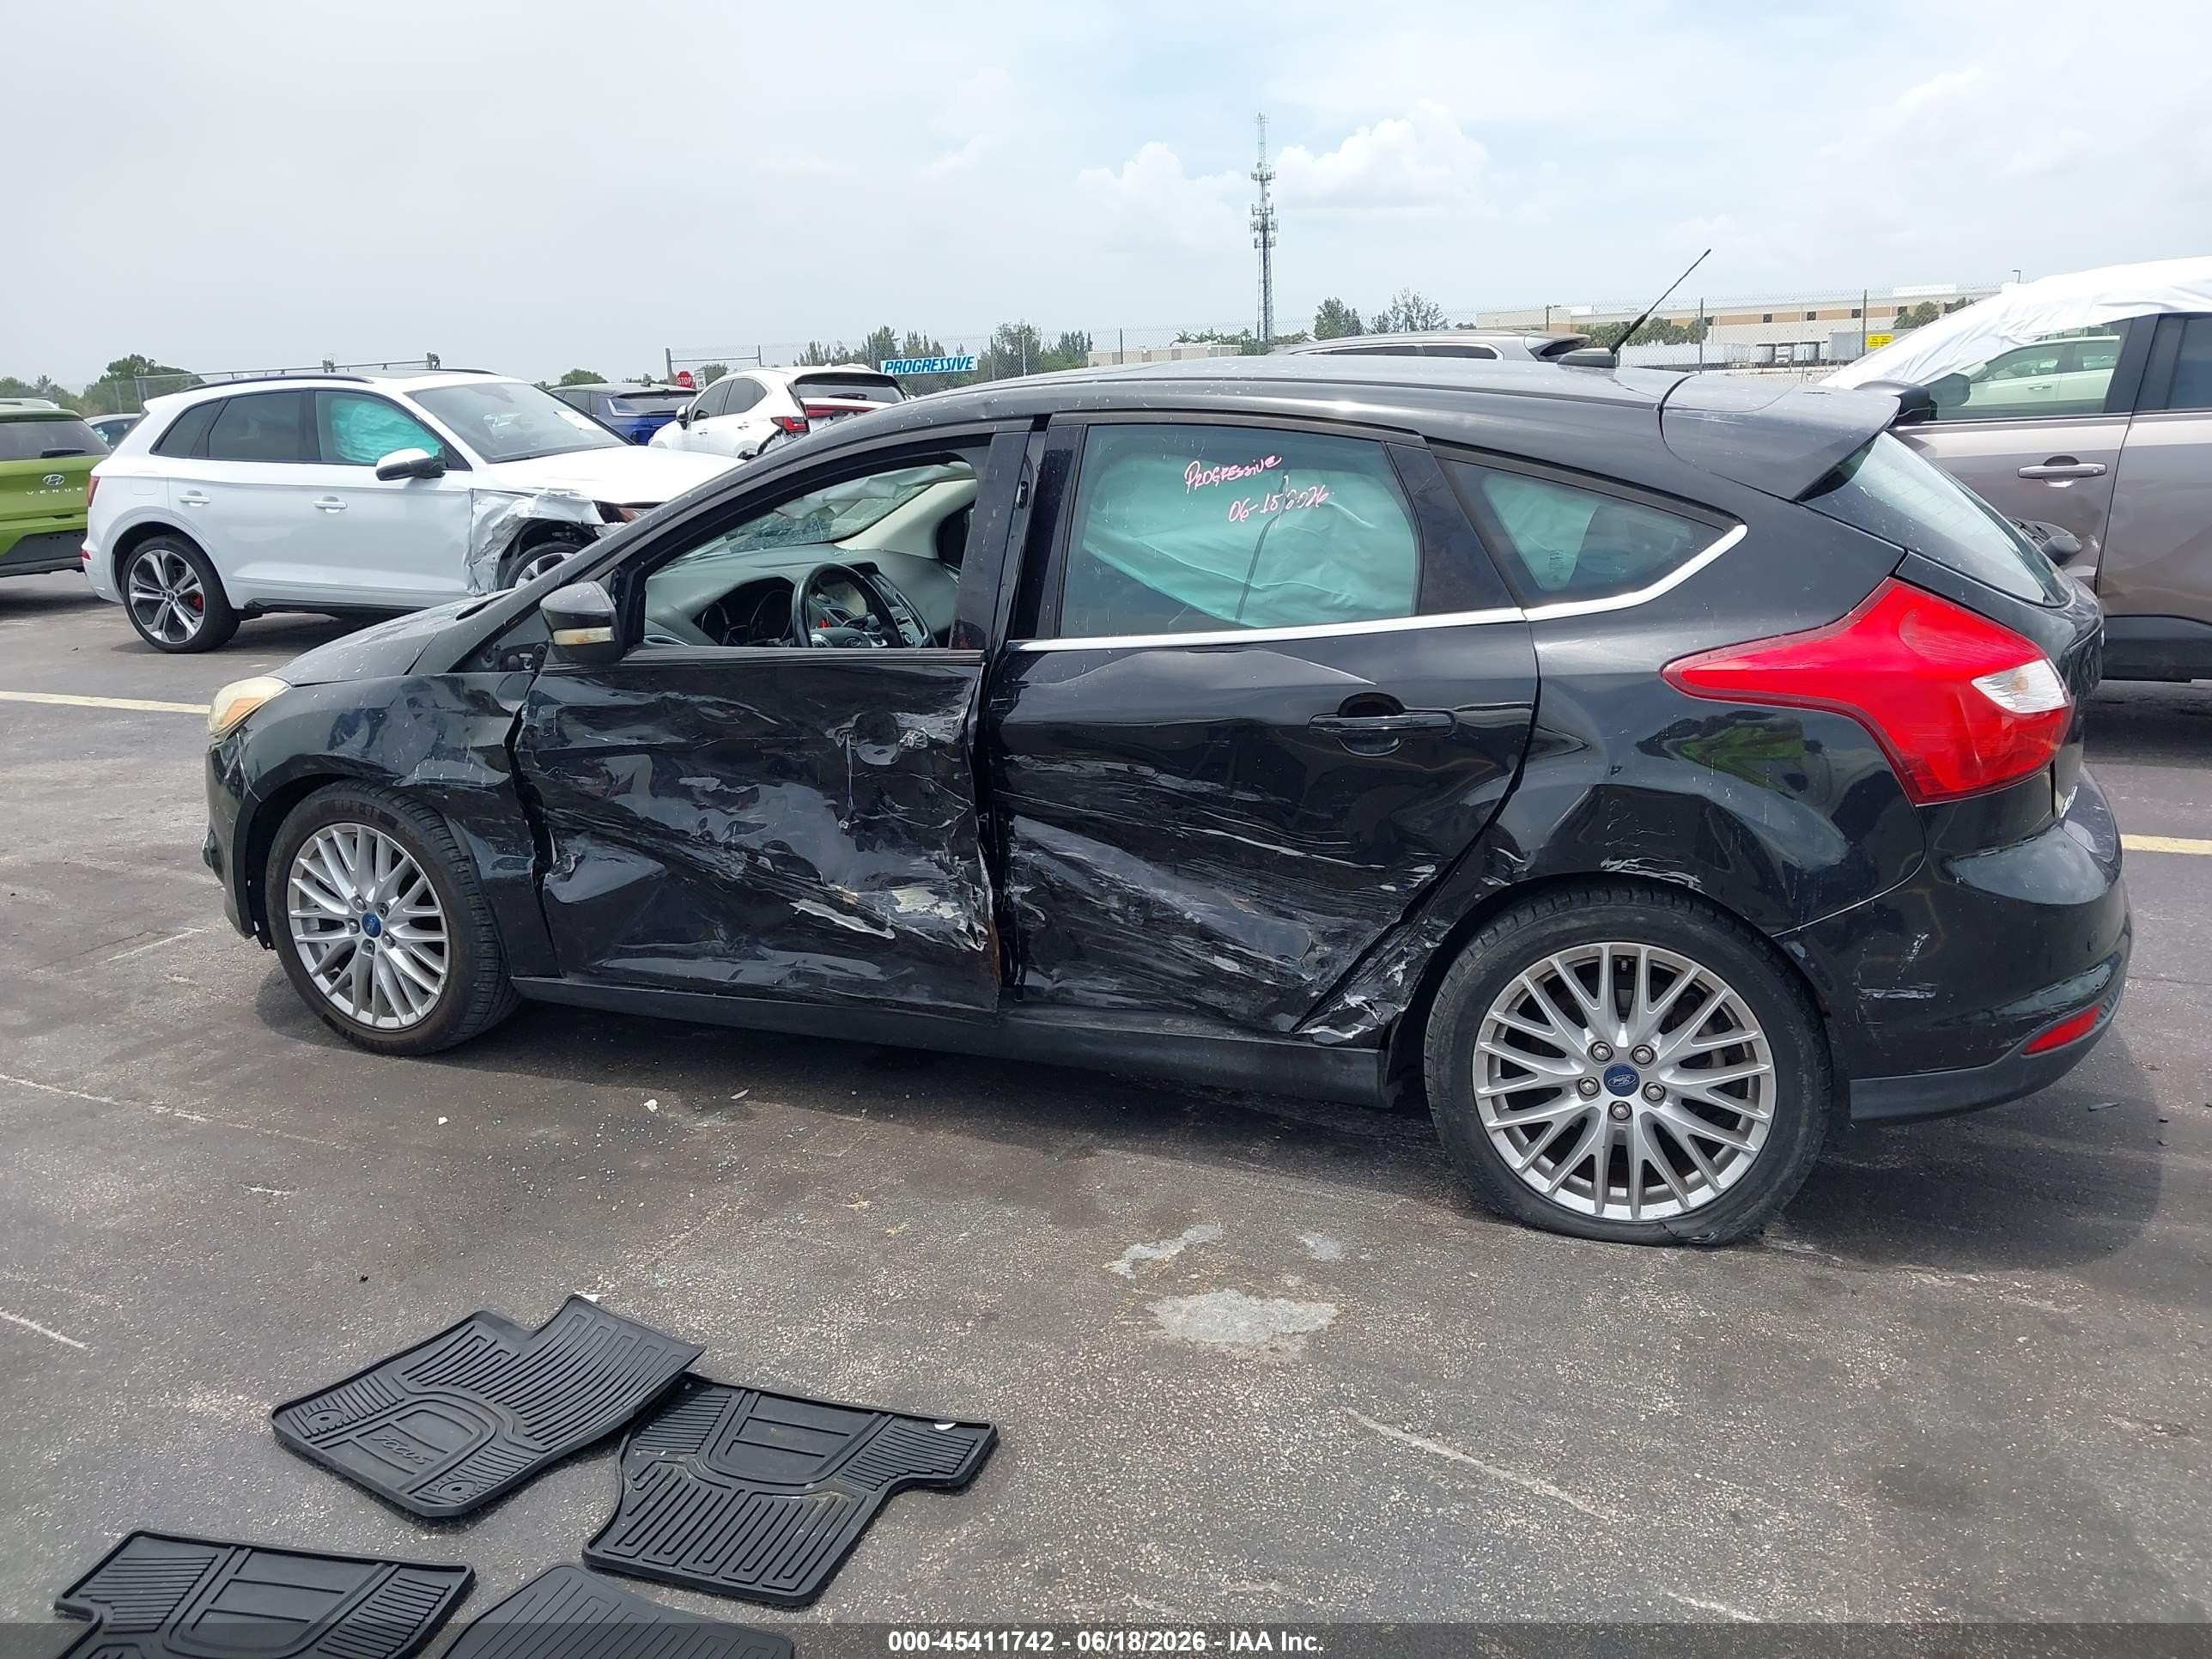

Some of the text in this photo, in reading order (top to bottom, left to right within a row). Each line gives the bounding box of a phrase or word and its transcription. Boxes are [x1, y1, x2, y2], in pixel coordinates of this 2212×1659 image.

[884, 356, 975, 374] PROGRESSIVE
[678, 377, 692, 386] STOP
[26, 487, 83, 495] VENUE
